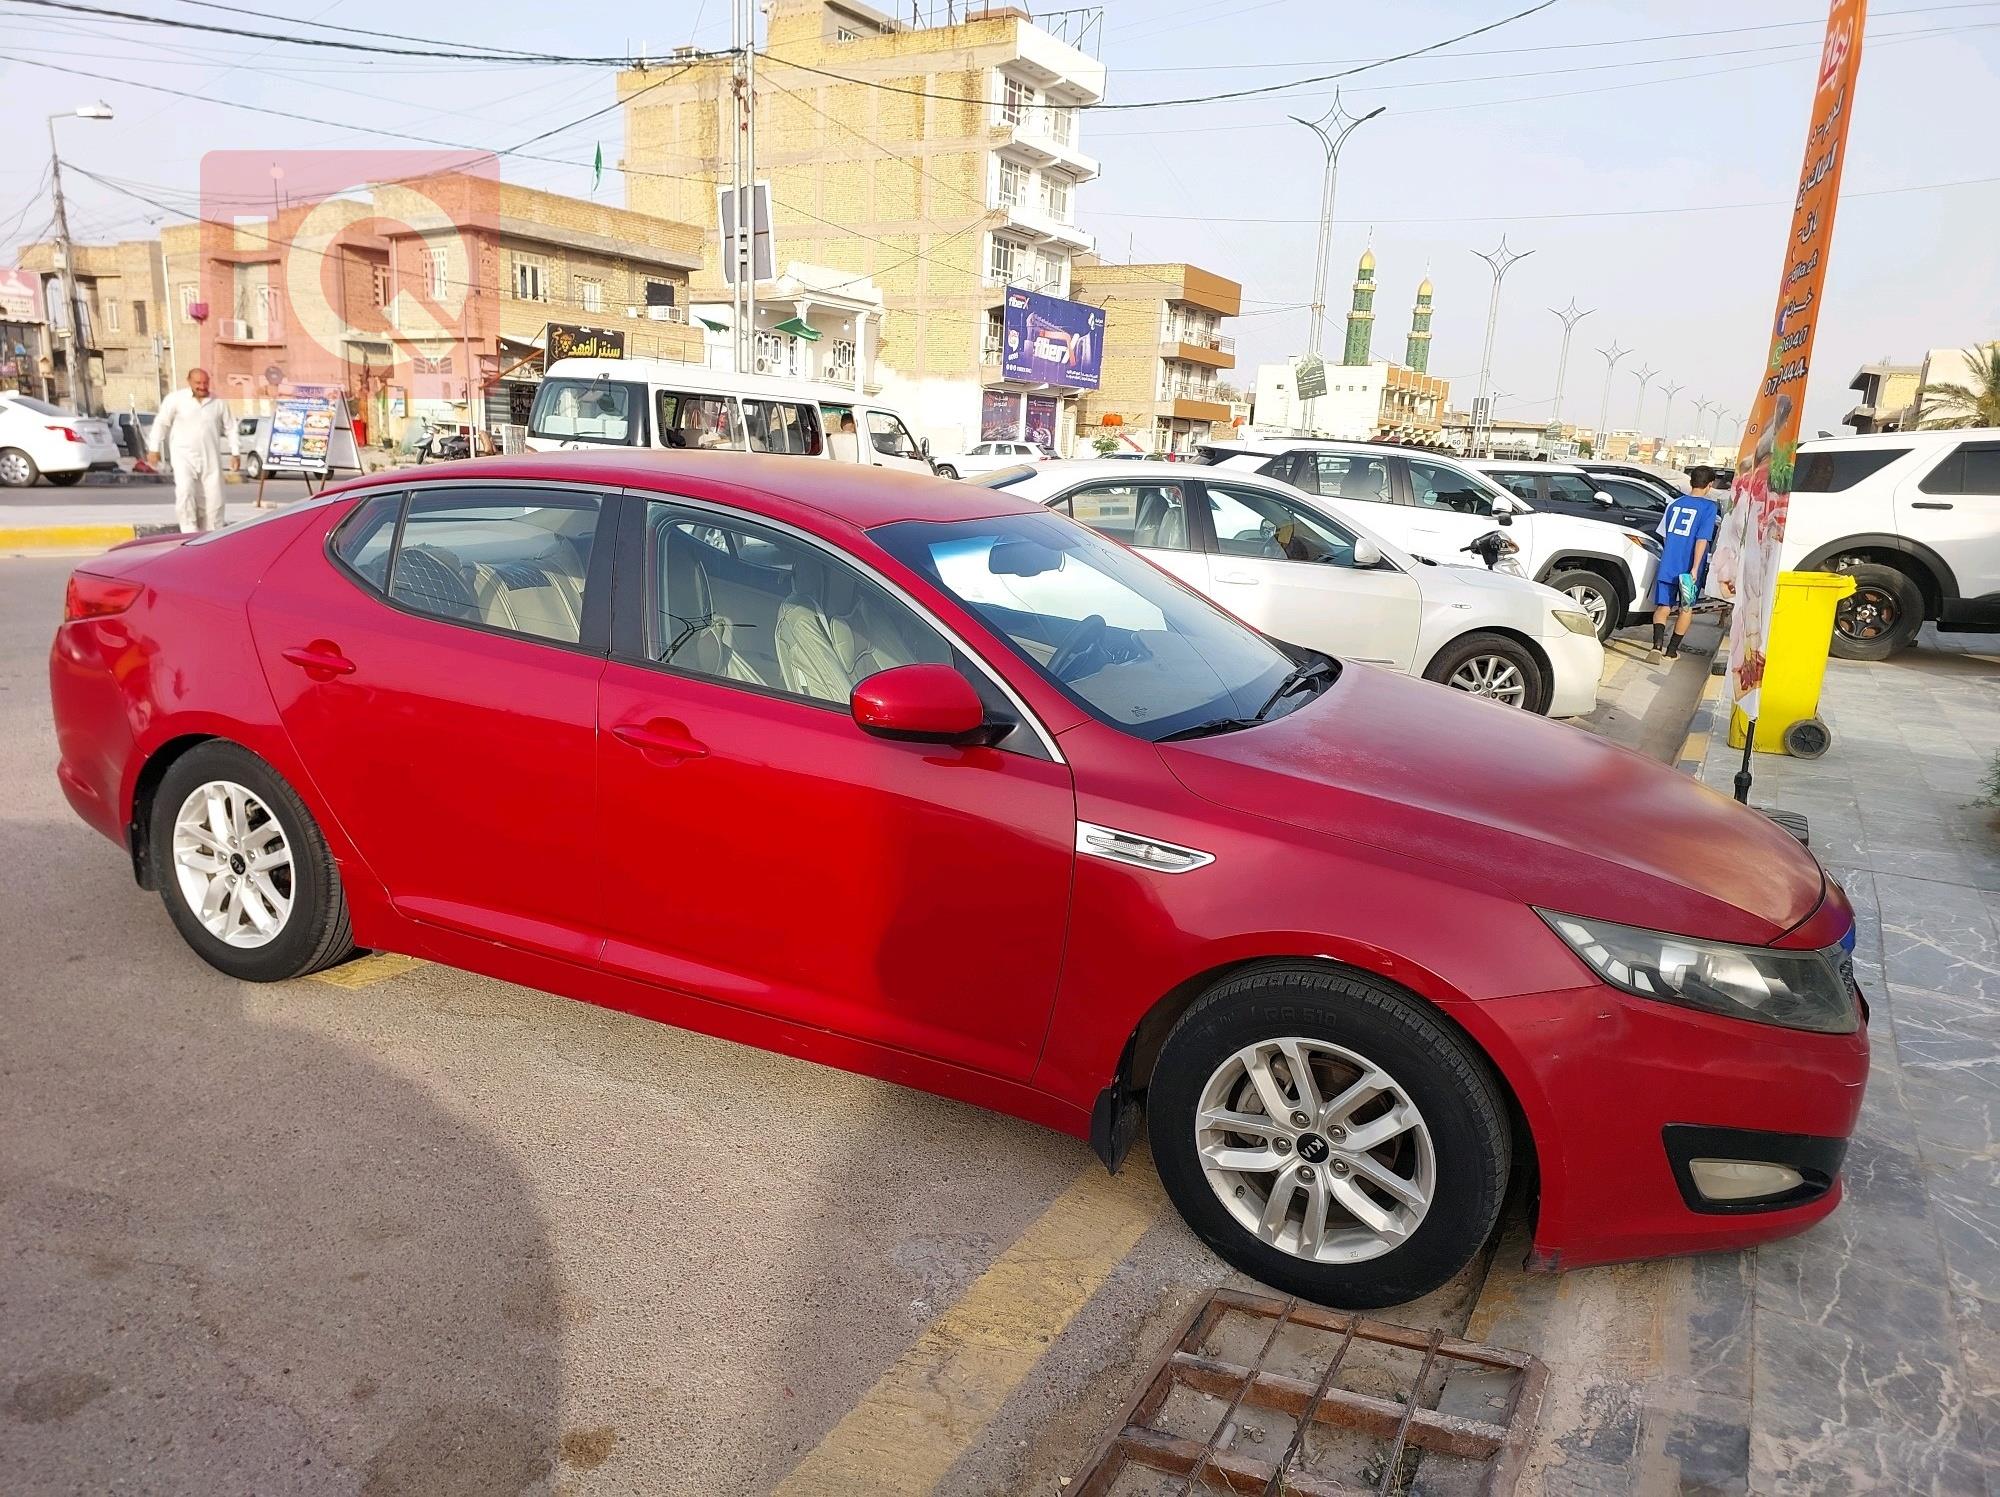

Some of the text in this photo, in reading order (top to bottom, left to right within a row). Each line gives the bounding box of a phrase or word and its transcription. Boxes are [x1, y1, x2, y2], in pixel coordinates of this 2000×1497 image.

[568, 337, 621, 359] سنتر الفهد
[1668, 506, 1697, 537] 13
[1300, 1138, 1325, 1158] KIA
